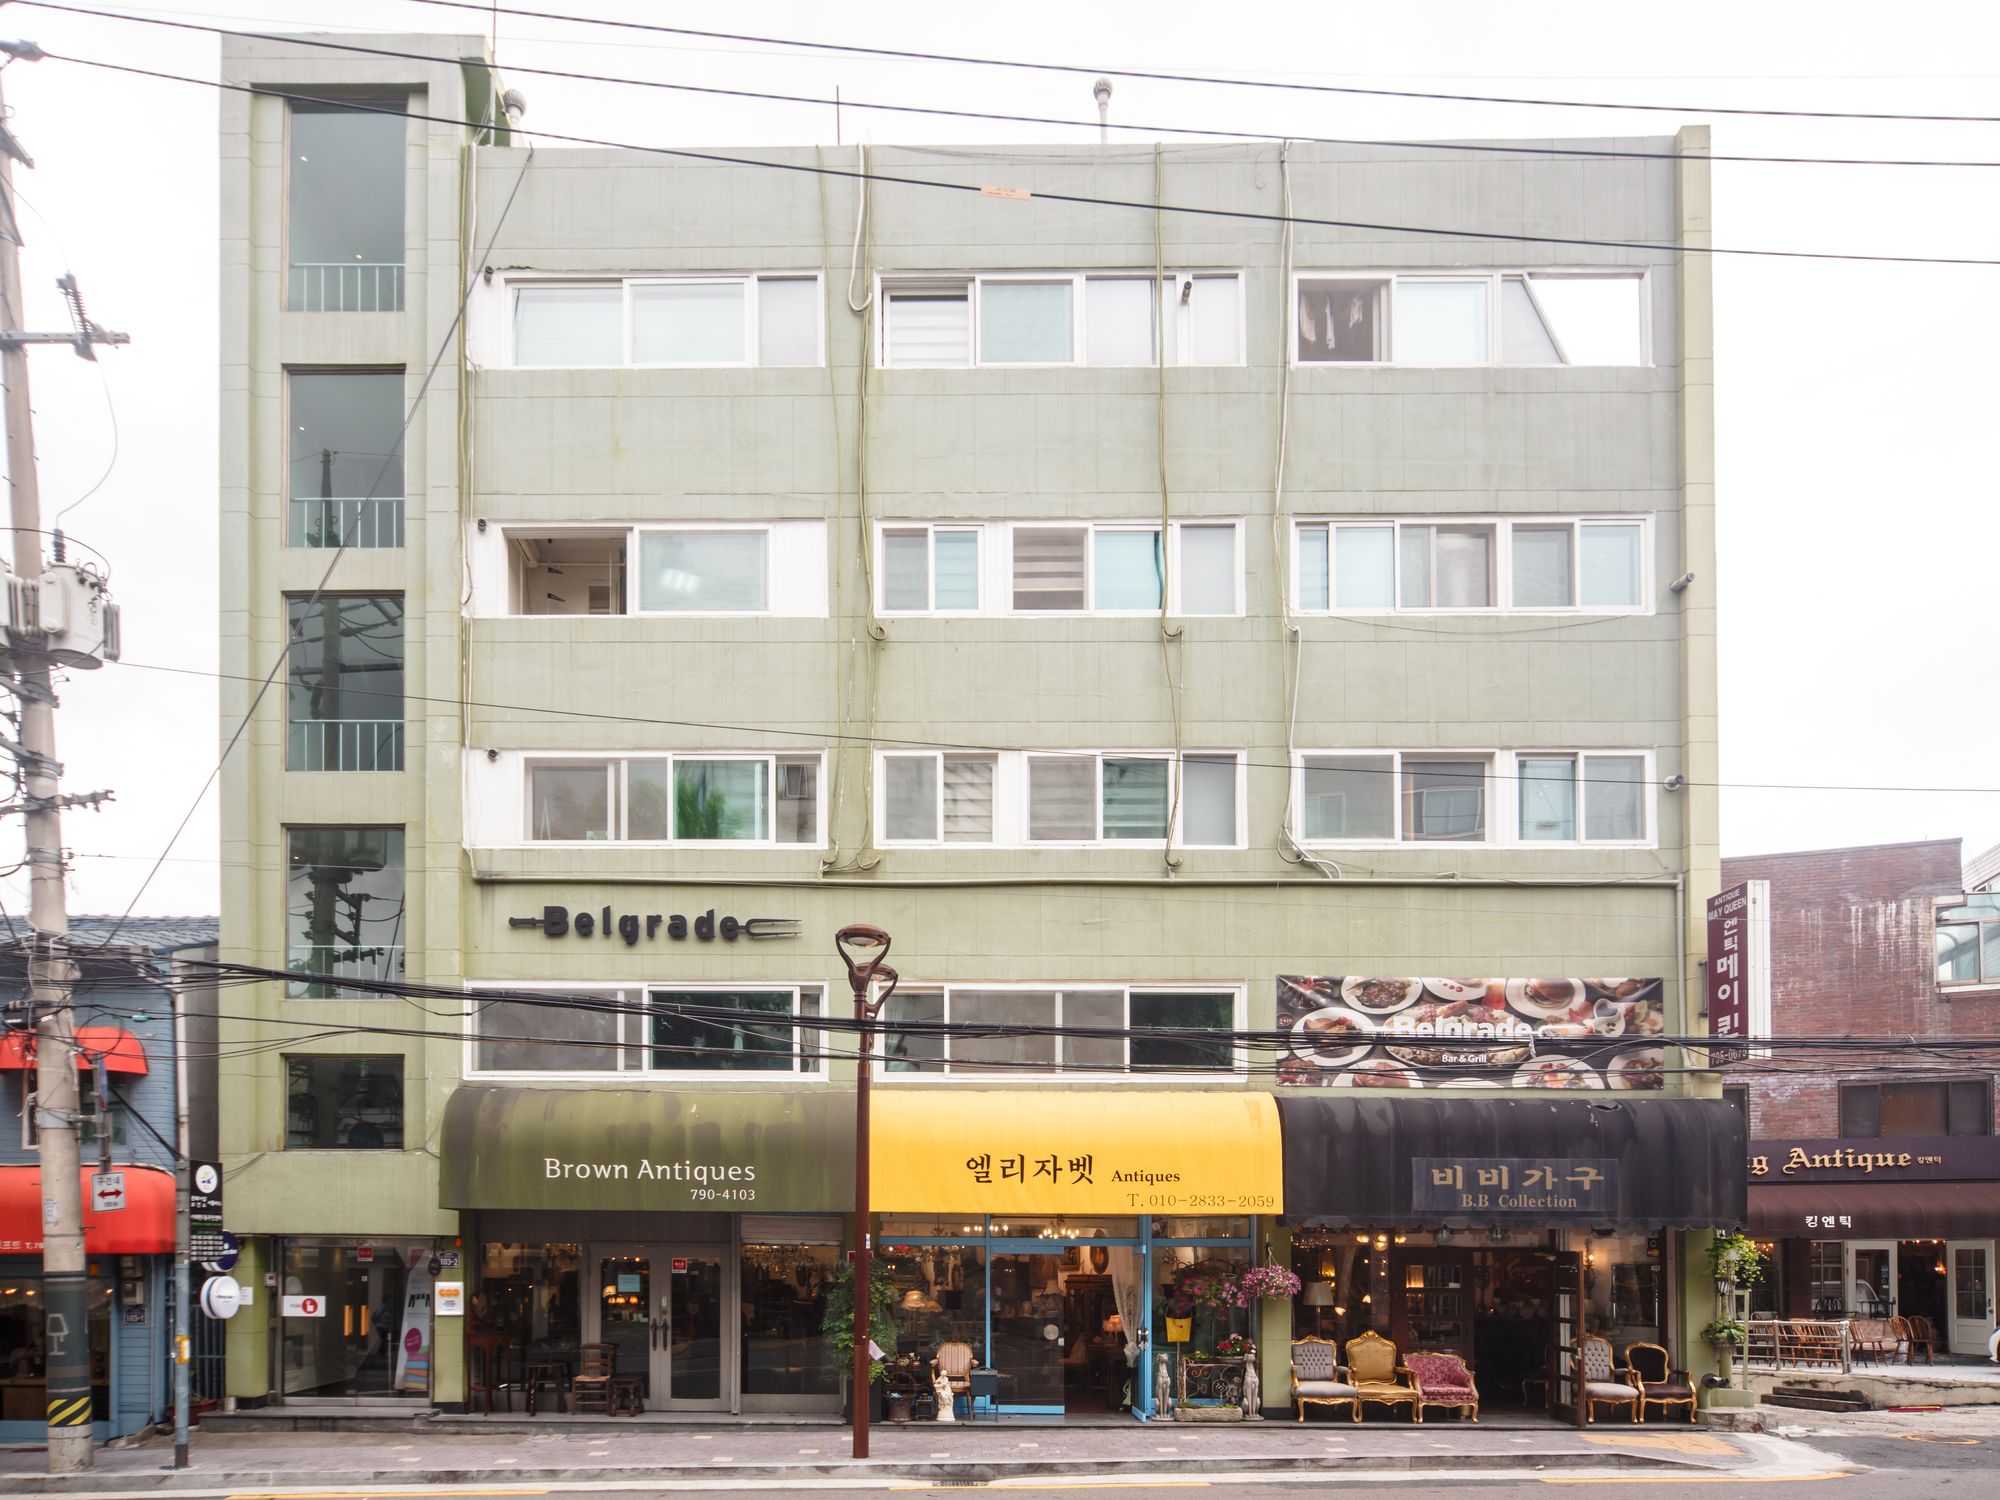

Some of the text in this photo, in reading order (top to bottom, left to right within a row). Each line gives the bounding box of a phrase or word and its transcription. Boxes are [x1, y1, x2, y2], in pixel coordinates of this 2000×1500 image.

[1714, 889, 1740, 906] ANTIQUE
[1709, 896, 1747, 921] MAY QUEEN
[544, 905, 739, 945] Belgrade
[1724, 917, 1738, 951] 엔틱
[1442, 1055, 1487, 1063] Bar & Grill
[966, 1153, 1094, 1185] 엘리자벳
[1746, 1147, 1912, 1175] g Antique
[544, 1158, 755, 1185] Brown Antiques
[1111, 1169, 1181, 1186] Antiques
[1431, 1165, 1605, 1191] 비비가구
[690, 1189, 755, 1201] 790-4103
[1126, 1194, 1275, 1208] T. 010-2833-2059
[1461, 1194, 1577, 1208] B.B Collection
[24, 1241, 44, 1250] T.79
[440, 1258, 458, 1266] 103-2
